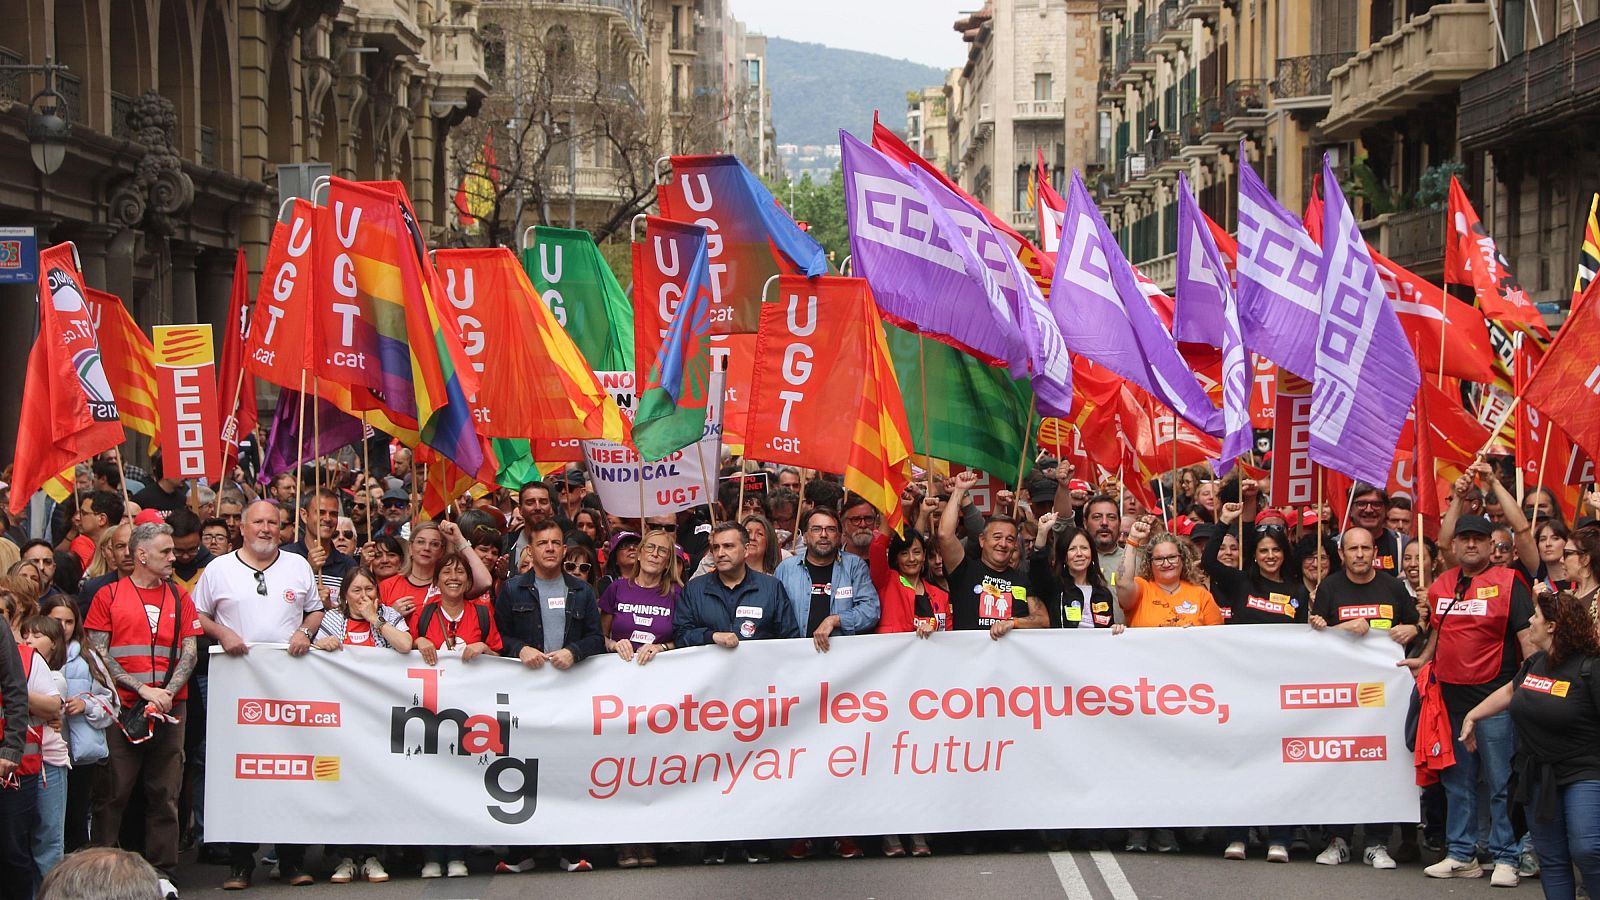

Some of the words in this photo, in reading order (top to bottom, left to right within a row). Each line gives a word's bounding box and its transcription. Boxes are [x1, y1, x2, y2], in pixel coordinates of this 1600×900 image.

[263, 217, 312, 345] UGT
[332, 201, 363, 346] UGT
[710, 306, 735, 322] cat
[252, 348, 275, 367] .cat
[326, 352, 366, 370] .cat
[779, 294, 817, 432] UGT
[603, 373, 634, 389] NO
[173, 369, 205, 475] CCOO
[765, 437, 801, 454] .cat
[656, 486, 700, 506] UGT
[617, 602, 671, 617] FEMINISTA
[1249, 597, 1282, 612] CCOO
[1341, 607, 1377, 618] CCOO
[1523, 676, 1553, 690] CCOO
[1285, 688, 1352, 705] CCOO
[265, 703, 337, 724] UGT.cat
[592, 684, 801, 743] Protegir
[819, 681, 889, 725] les
[908, 677, 1230, 730] conquestes,
[1308, 739, 1383, 759] UGT.cat
[241, 759, 308, 776] CCOO
[588, 747, 807, 800] guanyar
[828, 731, 871, 778] el
[892, 730, 1015, 776] futur
